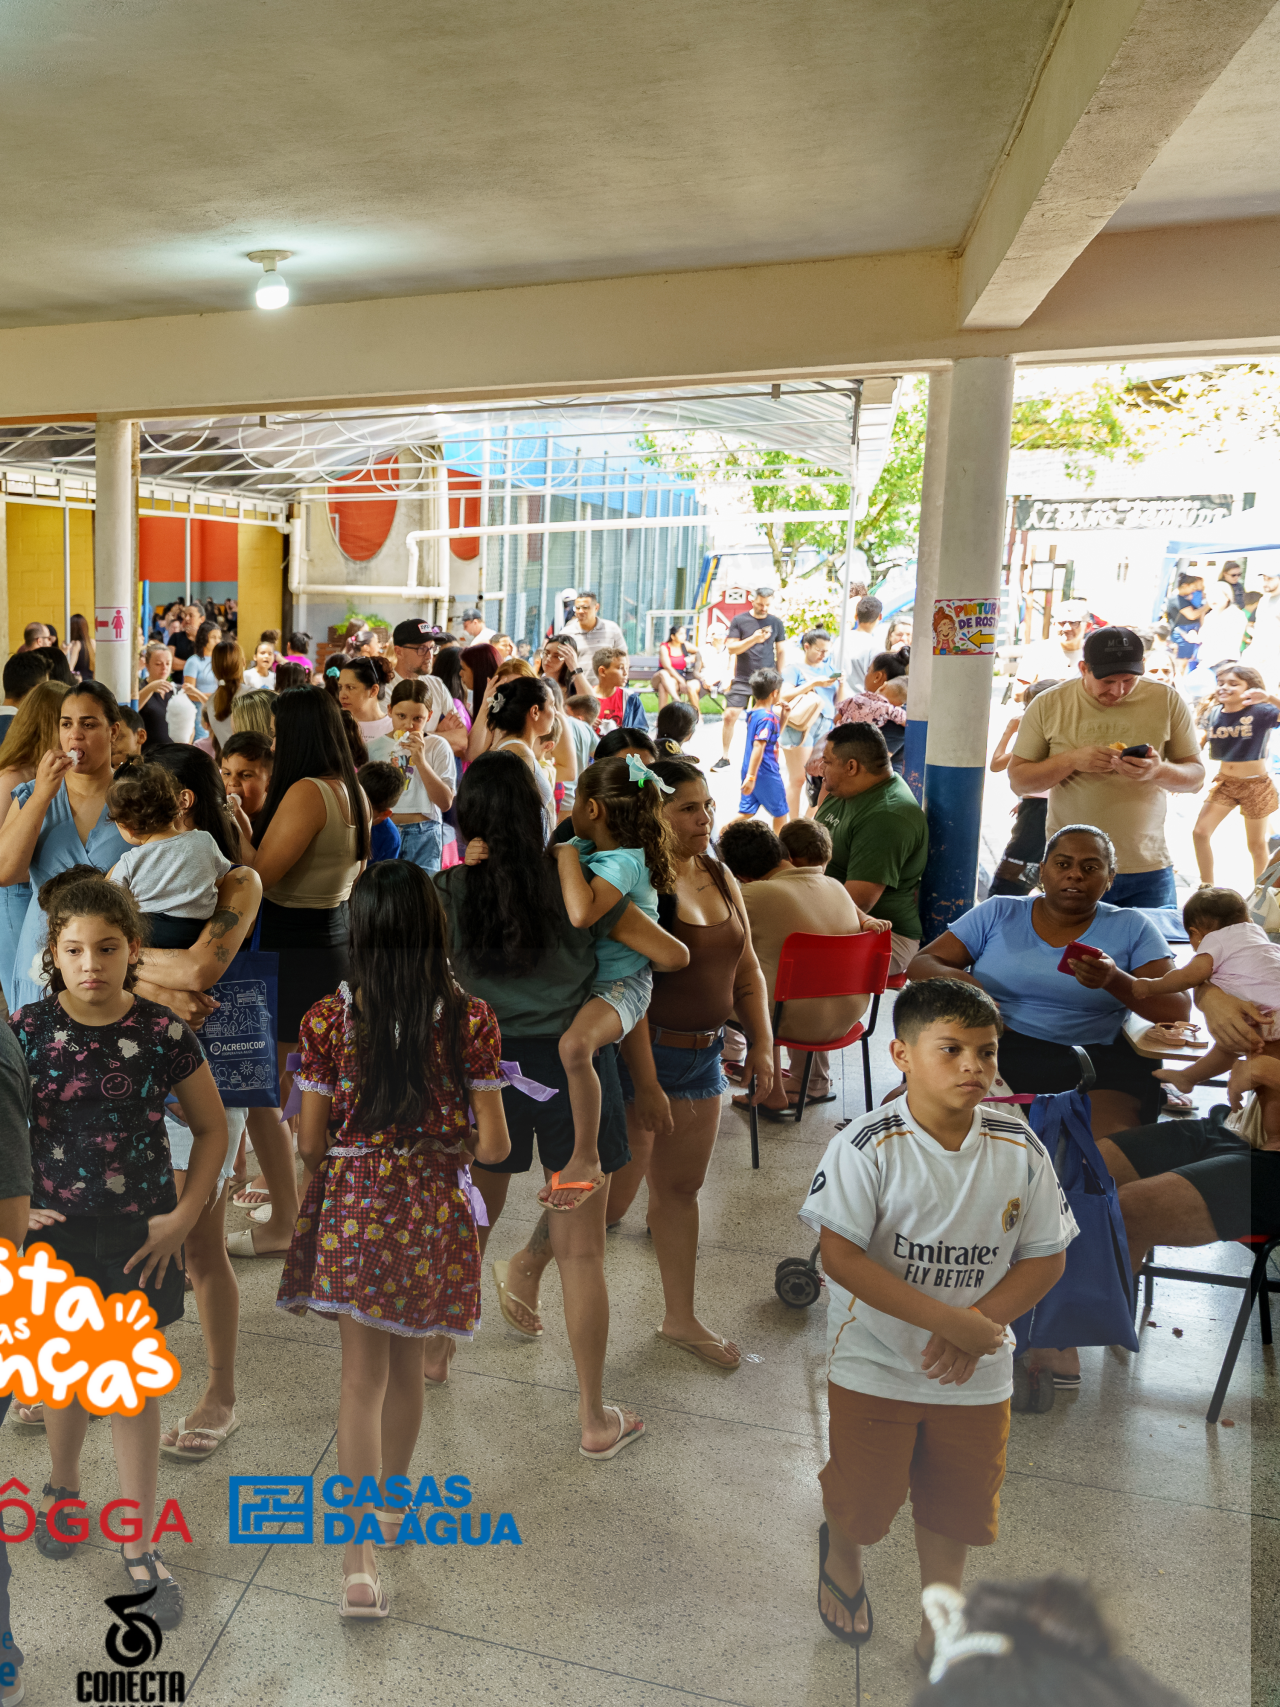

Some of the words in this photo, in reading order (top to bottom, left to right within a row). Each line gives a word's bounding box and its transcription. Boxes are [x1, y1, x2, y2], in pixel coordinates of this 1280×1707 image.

[958, 618, 972, 630] DE
[1209, 725, 1253, 738] LOVE
[222, 1041, 265, 1051] ACREDICOOP
[893, 1233, 1000, 1266] Emirates
[904, 1263, 931, 1285] FLY
[933, 1268, 985, 1289] BETTER
